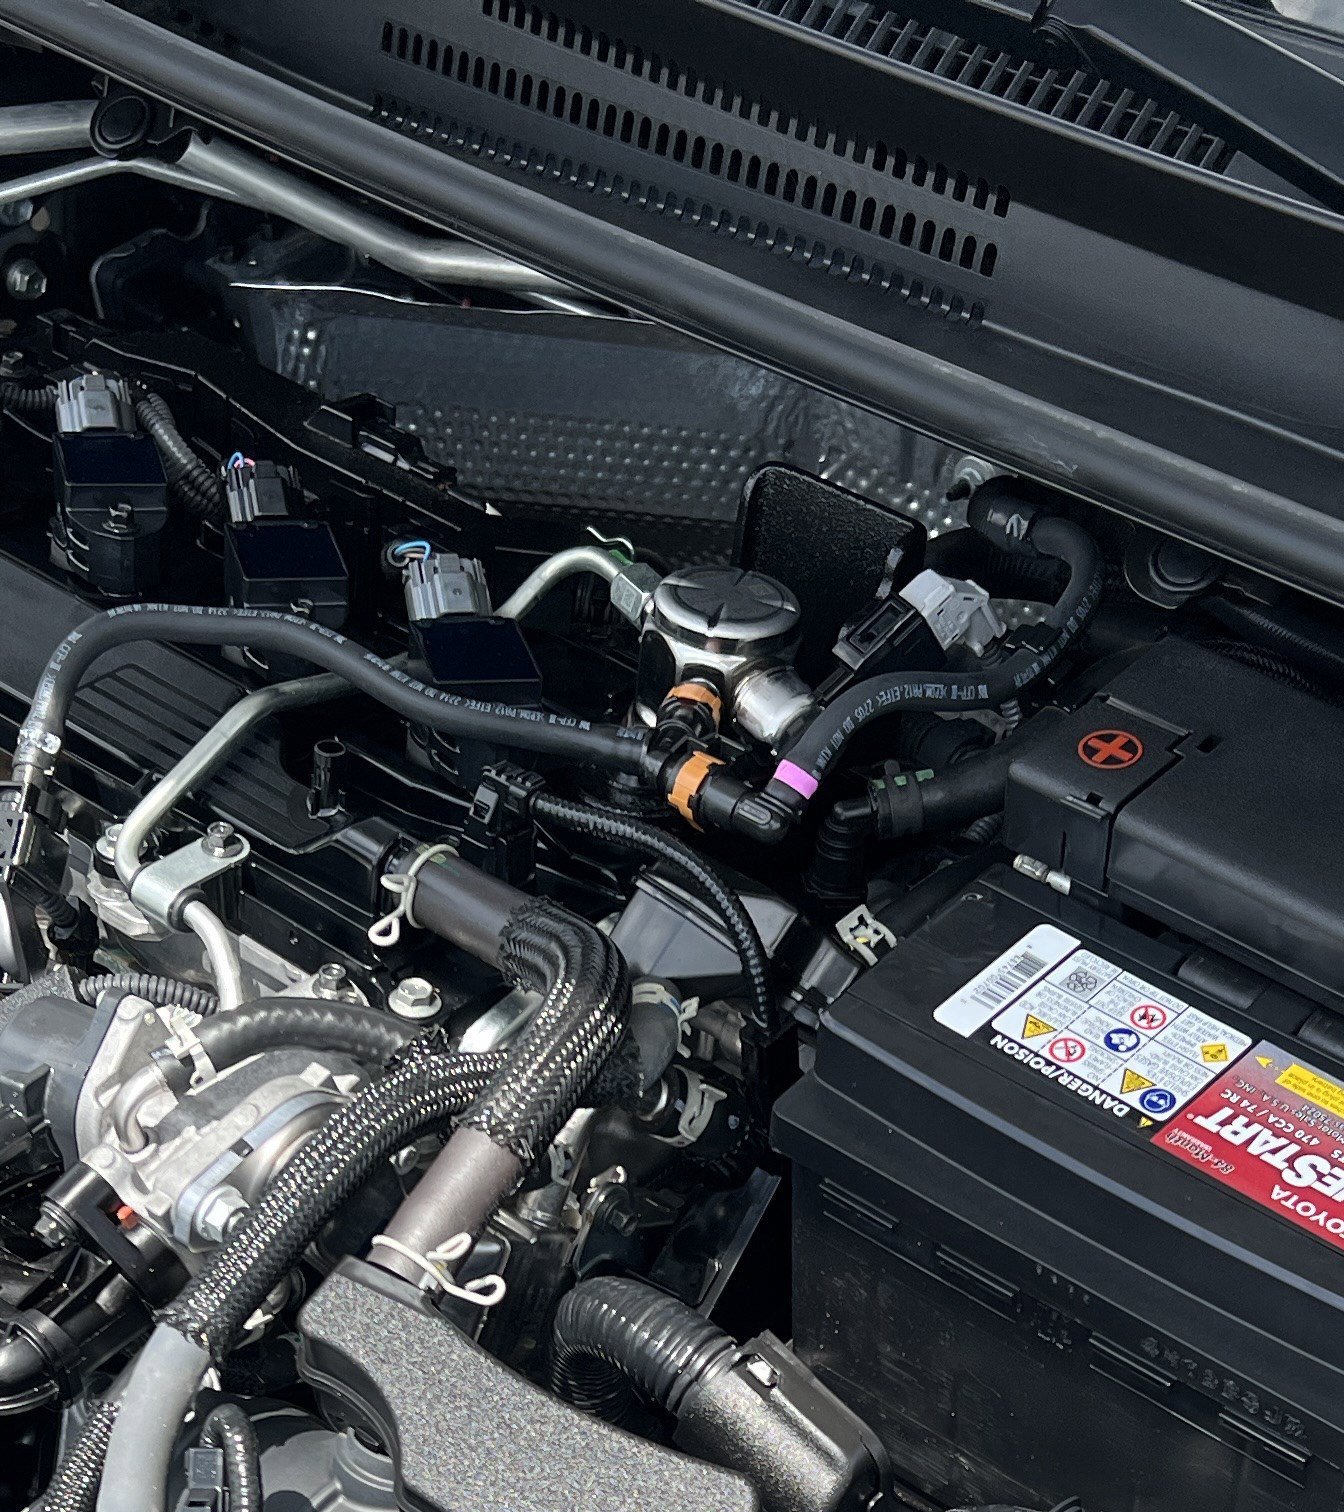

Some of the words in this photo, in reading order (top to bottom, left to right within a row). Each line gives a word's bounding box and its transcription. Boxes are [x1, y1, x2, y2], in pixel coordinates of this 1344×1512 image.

[988, 1033, 1130, 1117] DANGER/POISON
[1218, 1088, 1240, 1104] RC
[1238, 1098, 1258, 1113] 74
[1256, 1108, 1268, 1118] /
[1288, 1108, 1317, 1127] Sales
[1264, 1113, 1296, 1133] CCA
[1293, 1128, 1321, 1147] 470
